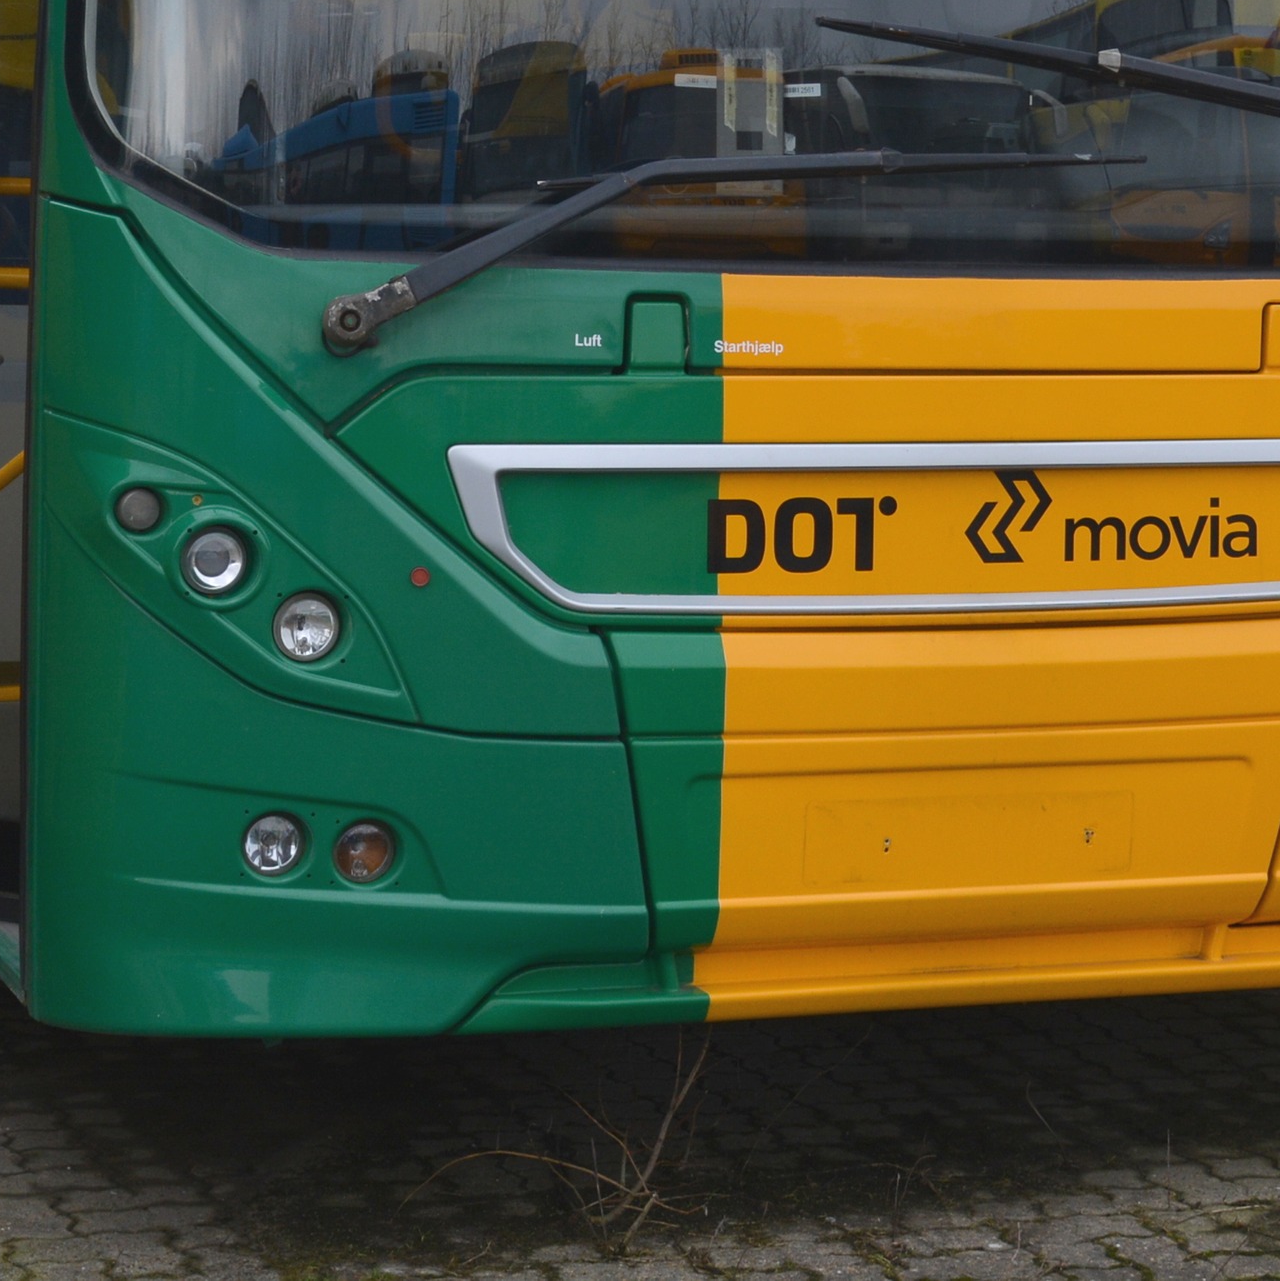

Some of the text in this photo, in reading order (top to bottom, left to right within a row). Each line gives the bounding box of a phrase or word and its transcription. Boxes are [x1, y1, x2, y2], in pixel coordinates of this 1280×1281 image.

[575, 334, 602, 347] Luft
[714, 340, 784, 355] Starthjælp
[707, 496, 898, 574] DOT
[1063, 497, 1259, 562] movia
